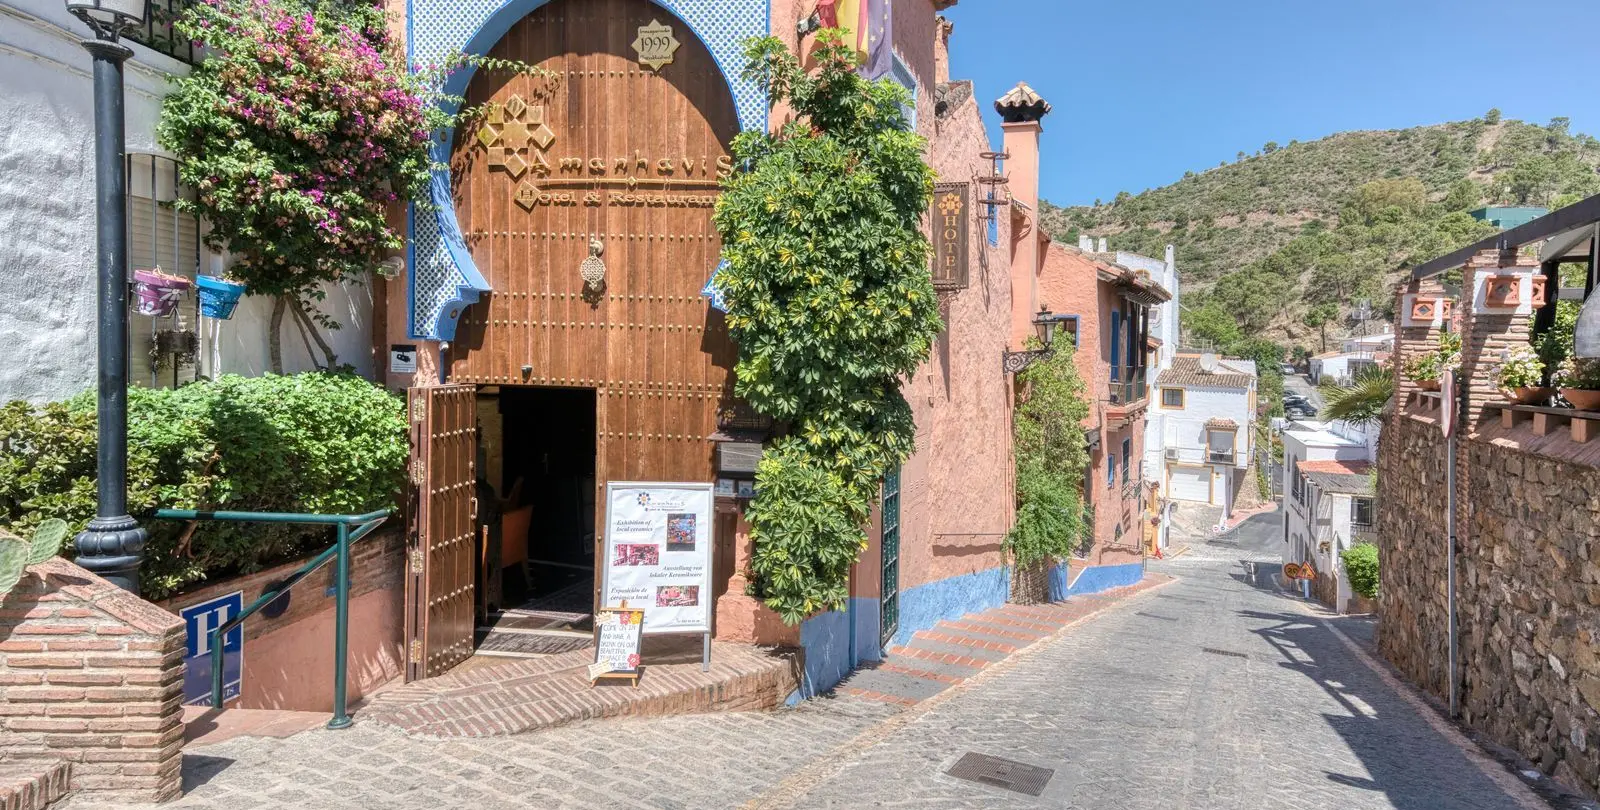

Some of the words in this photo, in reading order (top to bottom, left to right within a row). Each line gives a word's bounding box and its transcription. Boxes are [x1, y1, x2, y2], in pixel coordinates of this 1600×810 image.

[641, 36, 670, 52] 1999
[520, 190, 577, 203] Hotel
[608, 191, 716, 205] Restauran
[944, 215, 957, 280] HOTEL
[193, 604, 231, 658] H
